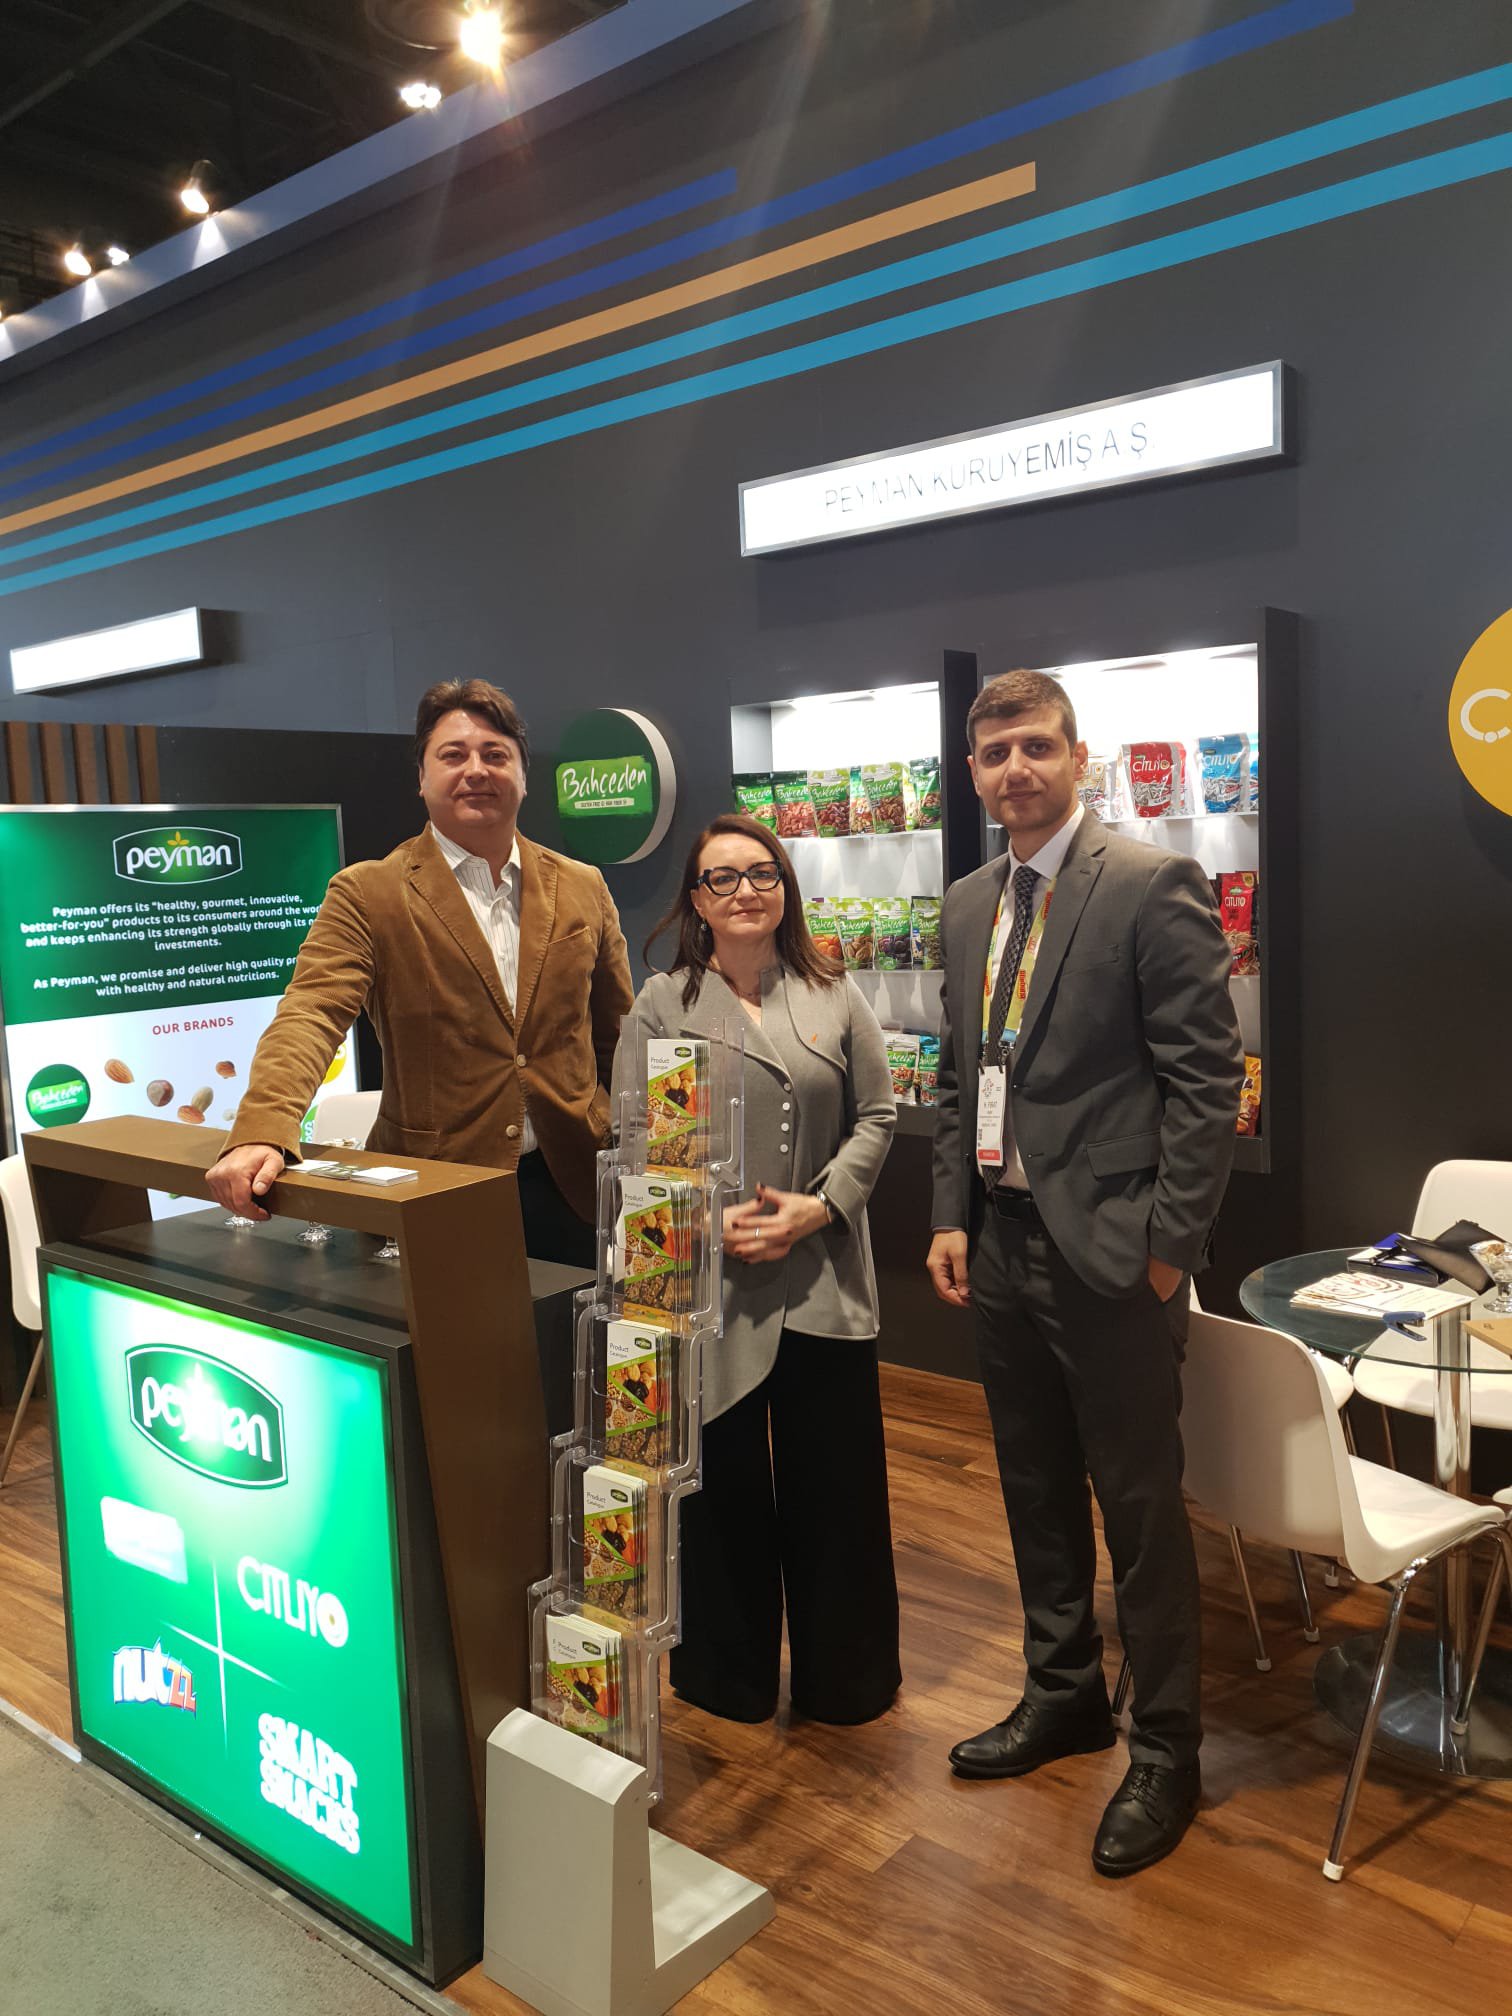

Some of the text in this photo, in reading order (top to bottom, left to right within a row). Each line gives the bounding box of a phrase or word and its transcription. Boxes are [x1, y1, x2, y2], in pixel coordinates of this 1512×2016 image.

[933, 430, 1092, 492] KURUYEMİŞ
[562, 763, 647, 799] Bahçeden
[126, 844, 232, 874] peyman
[52, 906, 98, 918] Peyman
[100, 903, 133, 914] offers
[135, 902, 150, 912] its
[202, 897, 248, 910] gourmet,
[250, 894, 303, 905] innovative,
[112, 915, 160, 929] products
[163, 914, 174, 923] to
[177, 912, 191, 922] its
[193, 909, 247, 922] consumers
[250, 906, 283, 918] around
[285, 905, 300, 915] the
[26, 936, 48, 947] and
[51, 934, 85, 946] keeps
[87, 930, 145, 942] enhancing
[147, 928, 162, 938] its
[164, 925, 209, 937] strength
[211, 921, 252, 934] globally
[253, 918, 292, 930] through
[294, 918, 306, 927] its
[154, 937, 222, 951] investments.
[33, 978, 48, 989] As
[51, 975, 99, 988] Peyman,
[101, 972, 117, 982] we
[119, 968, 164, 982] promise
[166, 966, 186, 976] and
[188, 962, 227, 974] deliver
[226, 959, 249, 971] high
[250, 956, 284, 970] quality
[96, 971, 280, 997] with healthy and natural nutritions.
[152, 1016, 234, 1035] OUR BRANDS
[141, 1376, 272, 1462] peyman
